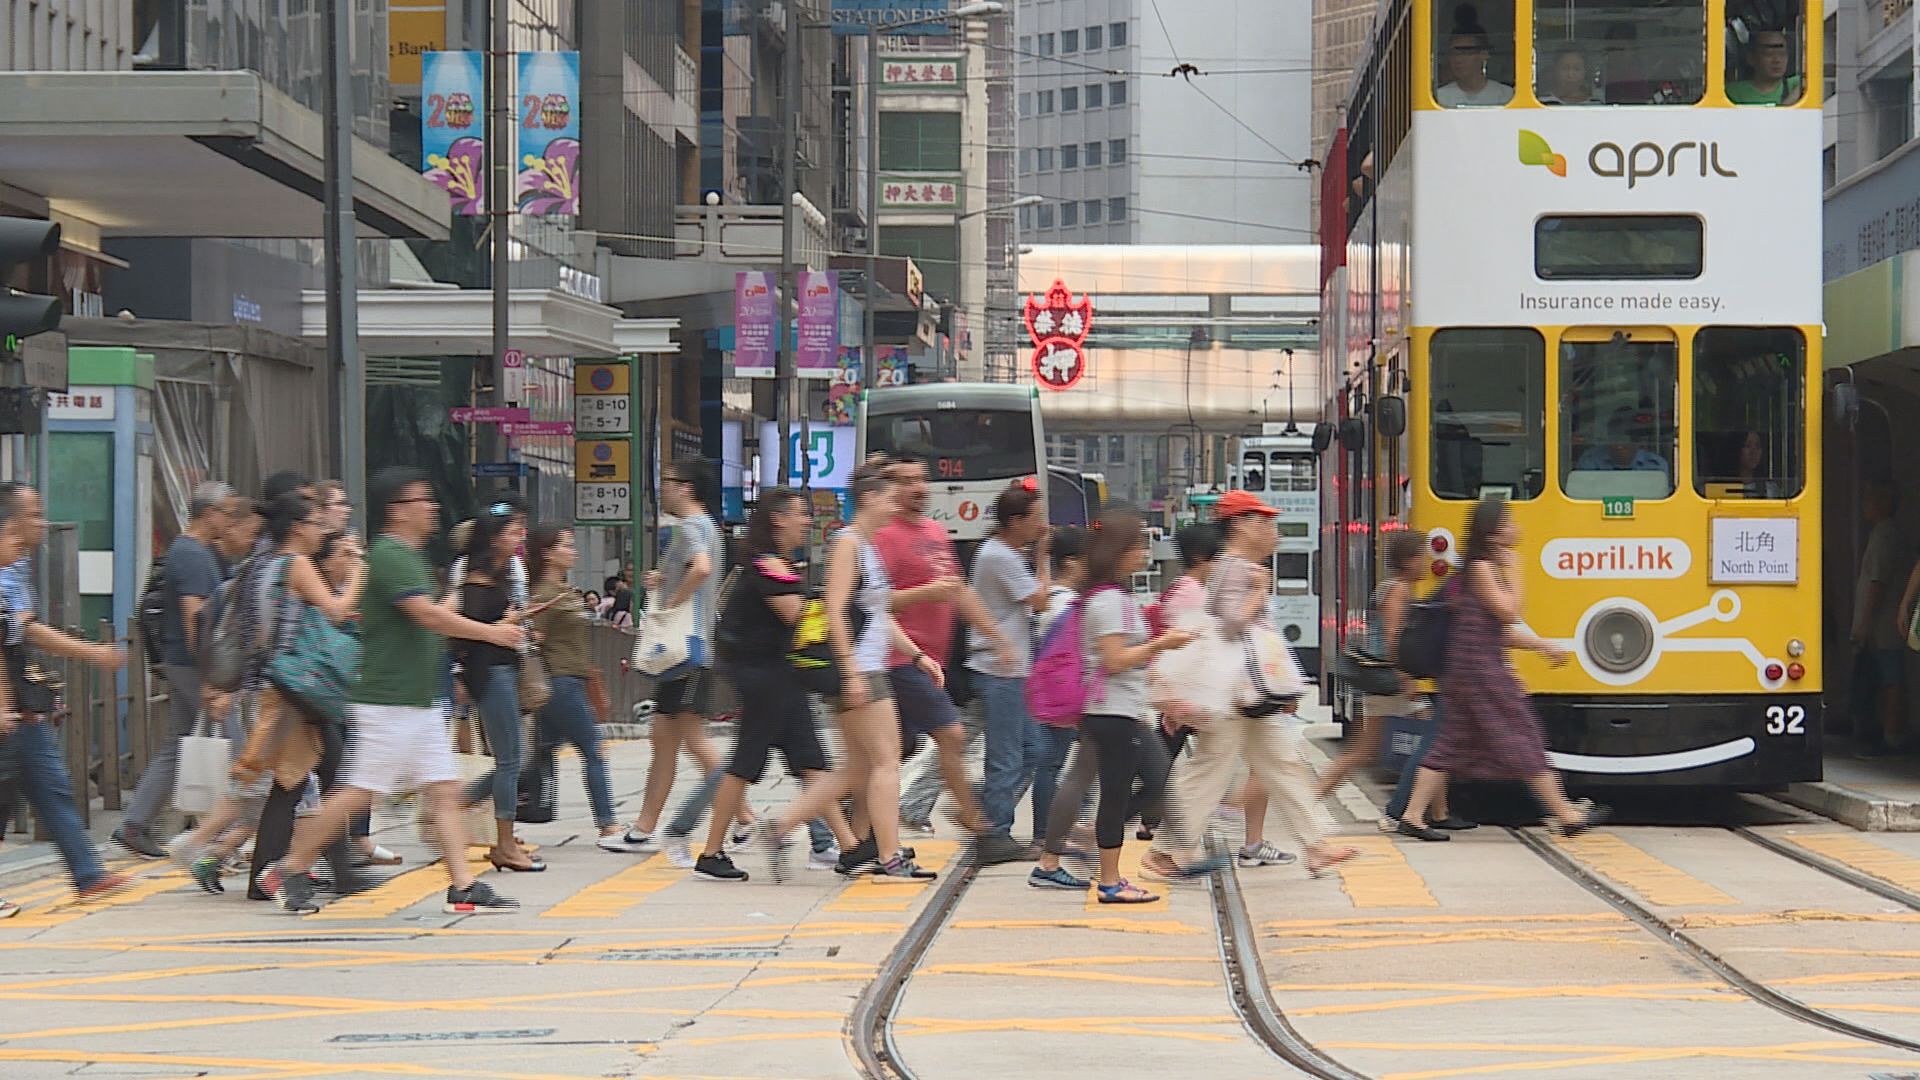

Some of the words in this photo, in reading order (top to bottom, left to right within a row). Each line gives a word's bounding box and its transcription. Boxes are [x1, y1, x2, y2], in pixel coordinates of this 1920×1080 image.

[832, 8, 948, 25] STATIONERS
[399, 41, 436, 55] Bank
[1589, 142, 1738, 189] april
[1520, 293, 1614, 310] Insurance
[1621, 293, 1672, 310] made
[1679, 296, 1726, 313] easy.
[597, 400, 626, 410] 8-10
[597, 417, 621, 427] 5-7
[939, 459, 964, 477] 914
[597, 487, 627, 498] 8-10
[597, 504, 619, 514] 4-7
[1606, 501, 1632, 514] 108
[1735, 531, 1775, 553] 北角
[1558, 545, 1673, 576] april.hk
[1721, 560, 1754, 575] North
[1758, 560, 1789, 575] Point
[1766, 706, 1805, 734] 32
